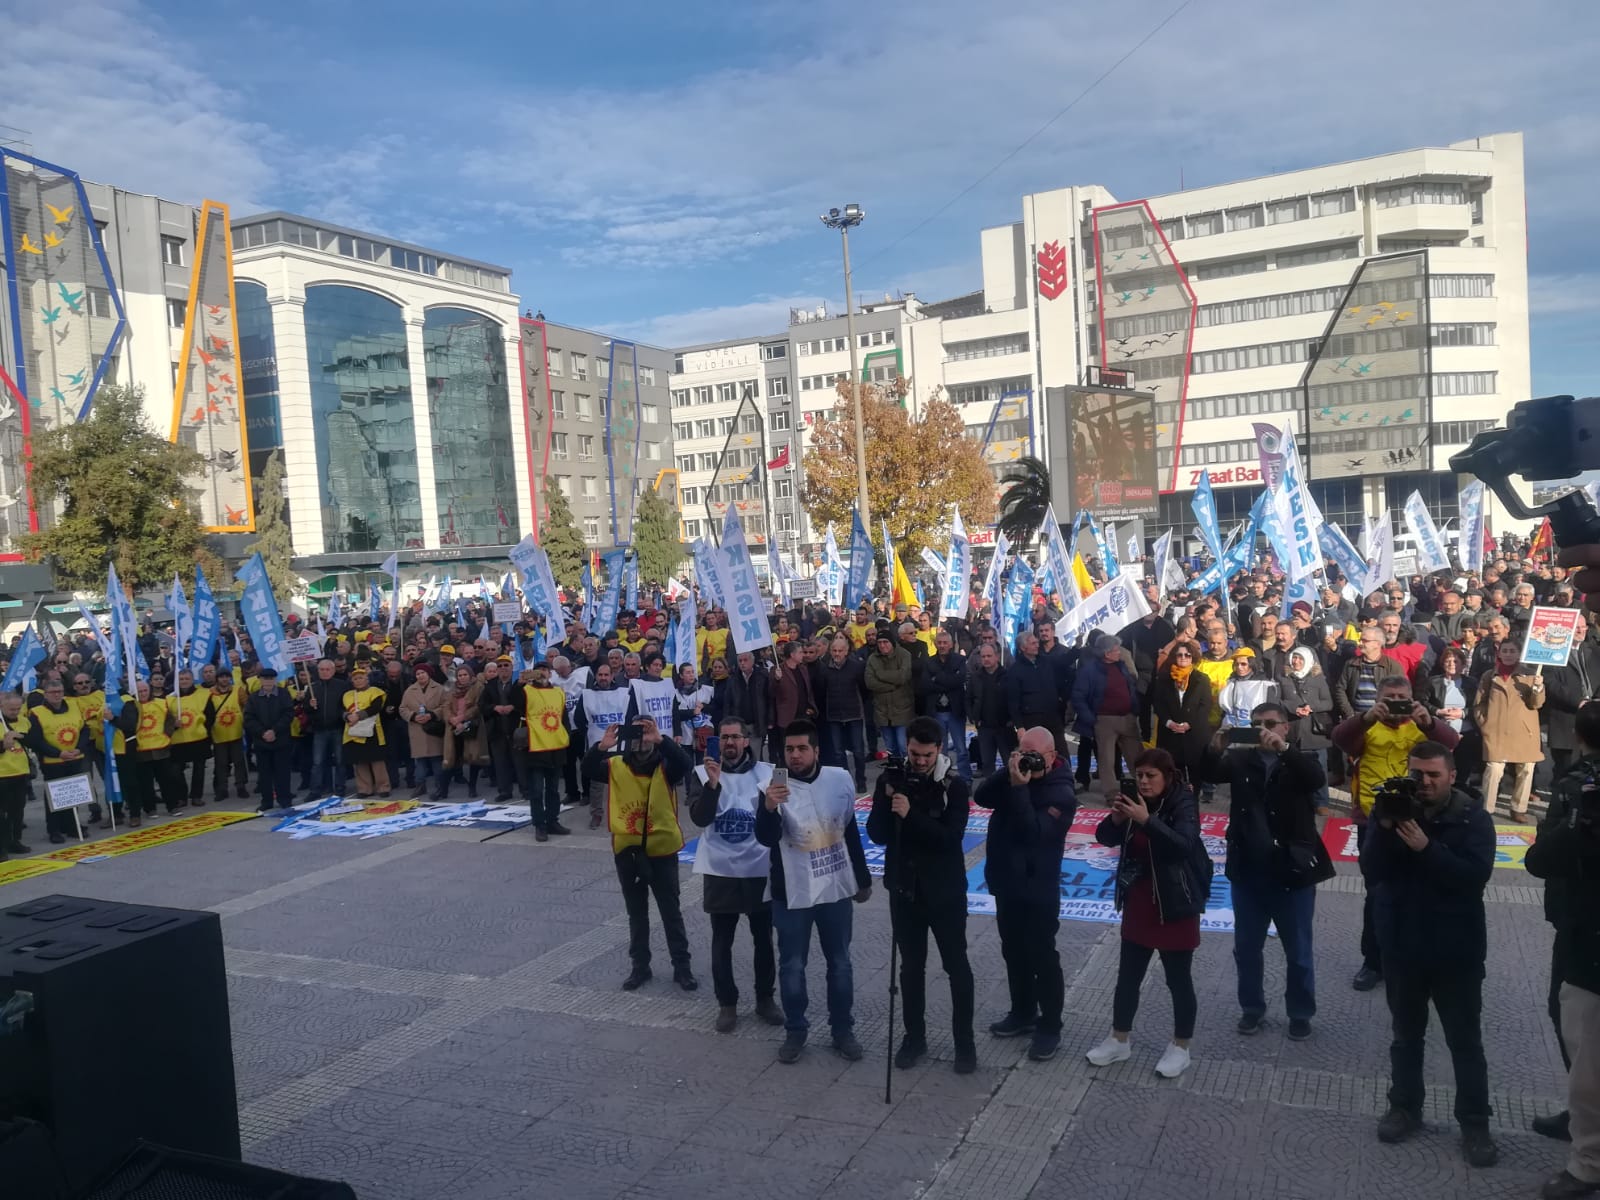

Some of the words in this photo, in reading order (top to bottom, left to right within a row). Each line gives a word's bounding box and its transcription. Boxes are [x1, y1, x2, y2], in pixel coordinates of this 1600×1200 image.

[968, 530, 993, 544] raat
[1284, 467, 1316, 568] KESK
[945, 539, 964, 610] KESK
